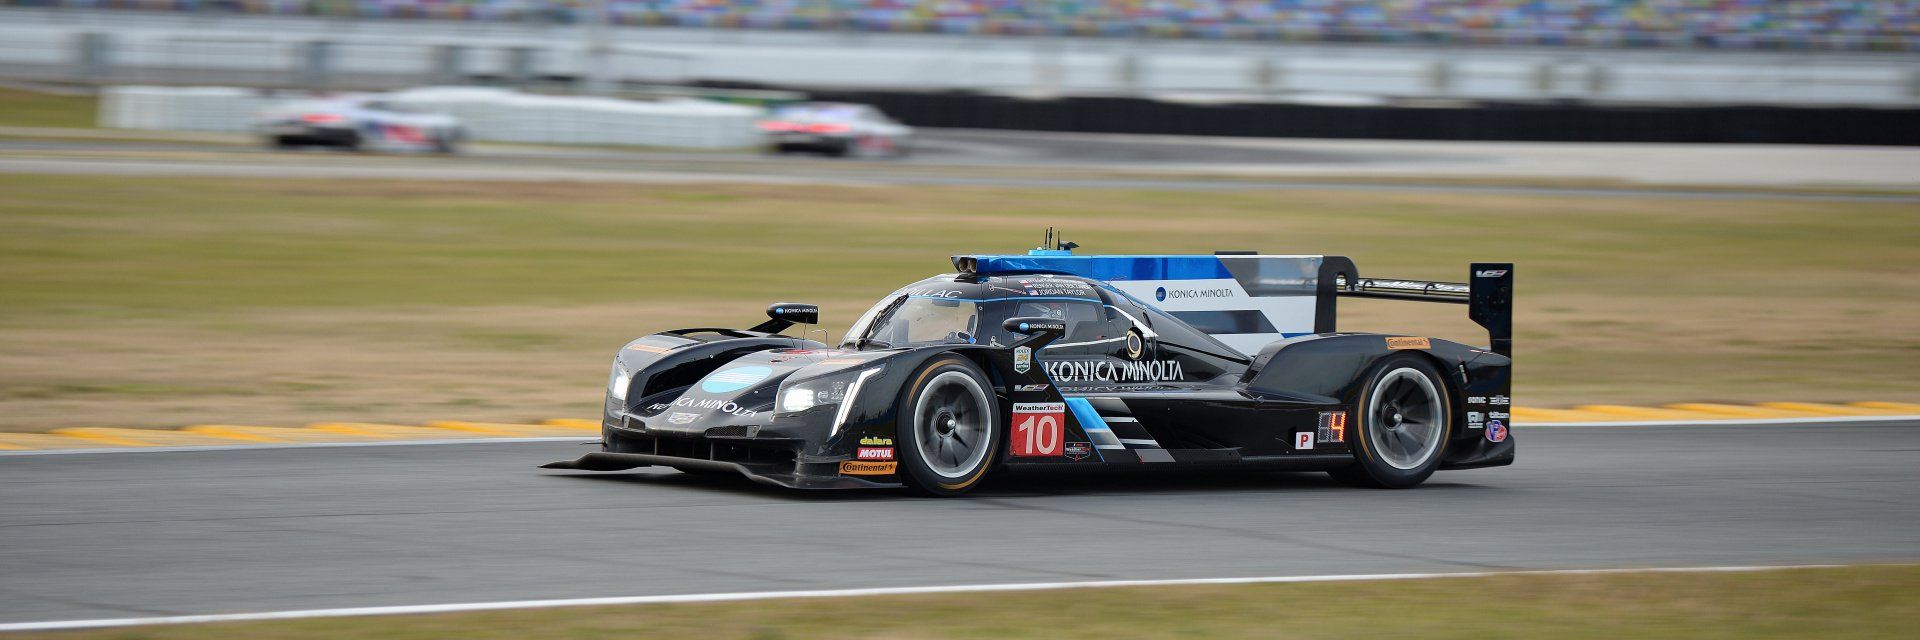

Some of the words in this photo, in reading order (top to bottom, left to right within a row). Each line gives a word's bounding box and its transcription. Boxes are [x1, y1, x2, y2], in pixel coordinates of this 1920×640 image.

[1168, 289, 1198, 299] KONICA
[1200, 288, 1233, 298] MINOLTA
[1044, 361, 1118, 382] KONICA
[1121, 360, 1184, 382] MINOLTA
[693, 399, 758, 418] MINOLTA
[1331, 411, 1347, 442] 4
[860, 436, 893, 446] dallara
[1019, 415, 1058, 455] 10
[1300, 434, 1309, 448] P
[859, 449, 893, 458] MOTUL
[843, 462, 888, 473] Continental
